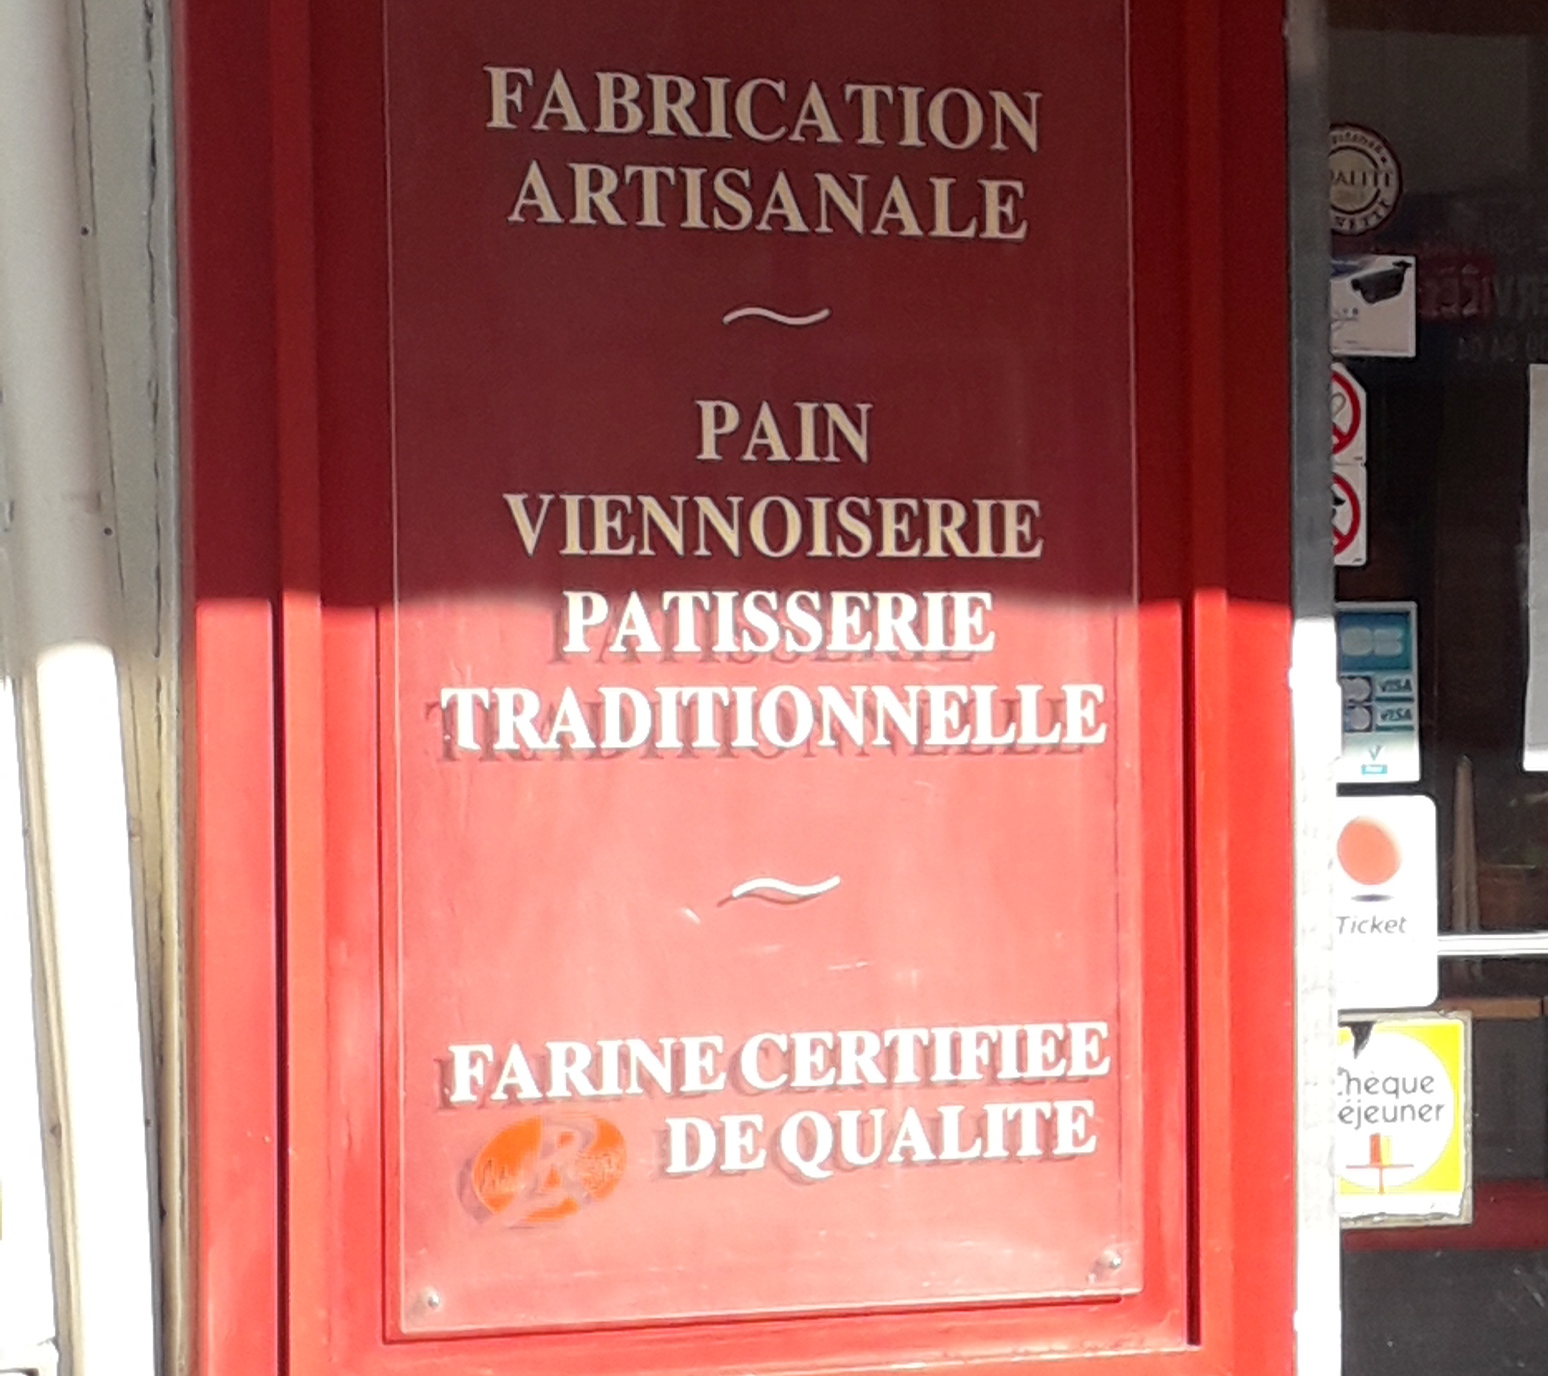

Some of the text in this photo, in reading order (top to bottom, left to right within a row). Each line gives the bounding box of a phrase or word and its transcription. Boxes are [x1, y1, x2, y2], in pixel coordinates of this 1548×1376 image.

[483, 65, 1043, 154] FABRICATION
[507, 160, 1028, 243] ARTISANALE
[695, 399, 874, 463] PAIN
[503, 492, 1044, 559] VIENNOISERIE
[562, 590, 998, 655] PATISSERIE
[440, 682, 1107, 752] TRADITIONNELLE
[1335, 914, 1407, 935] Ticket
[447, 1021, 1111, 1104] FARINE CERTIFIEE
[664, 1114, 766, 1175] DE
[780, 1100, 1097, 1180] QUALITE
[1337, 1099, 1445, 1130] éjeuner
